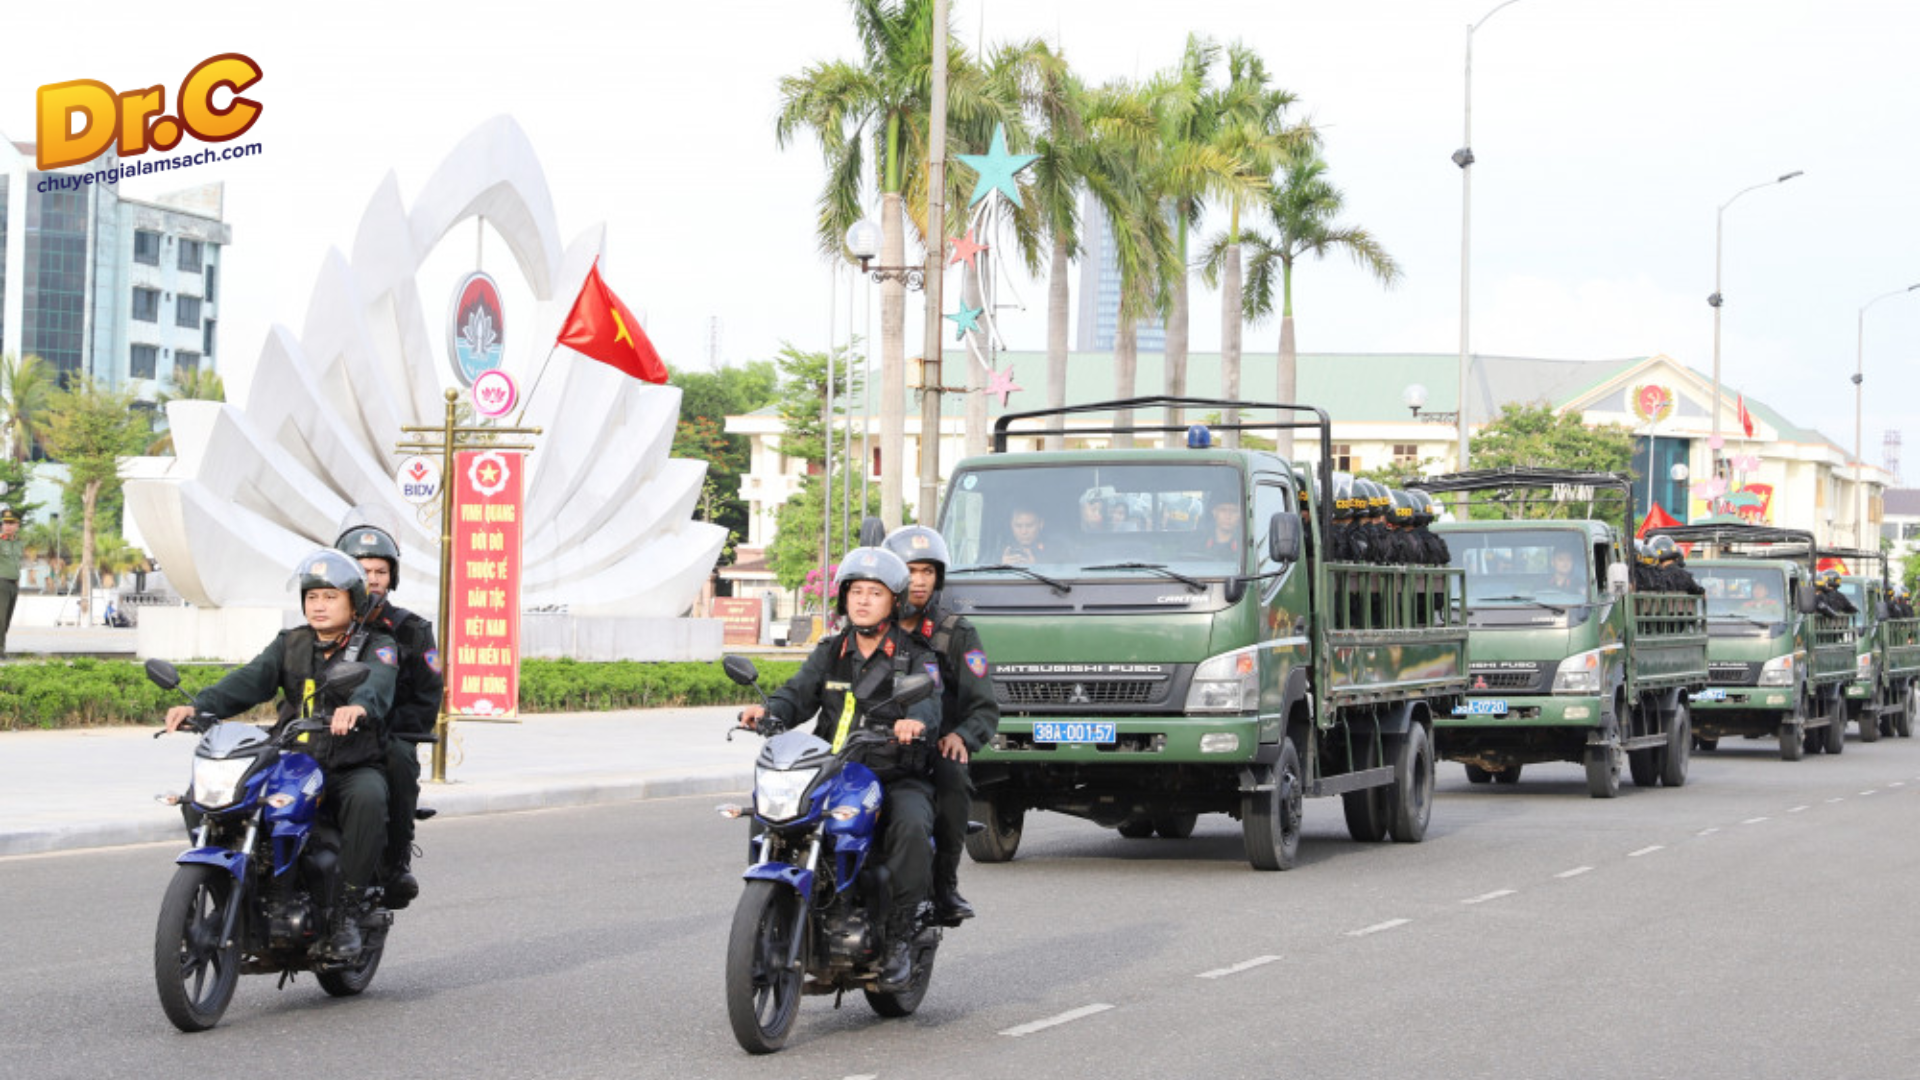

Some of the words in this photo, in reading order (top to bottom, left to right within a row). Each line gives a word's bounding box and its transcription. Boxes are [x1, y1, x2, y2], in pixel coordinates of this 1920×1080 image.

[404, 484, 434, 496] BIDV
[485, 504, 515, 524] QUANG
[465, 615, 484, 640] VIỆT
[486, 619, 507, 637] NAM
[996, 665, 1102, 673] MITSUBISHI
[1109, 665, 1162, 673] FUSO
[460, 675, 481, 694] ANH
